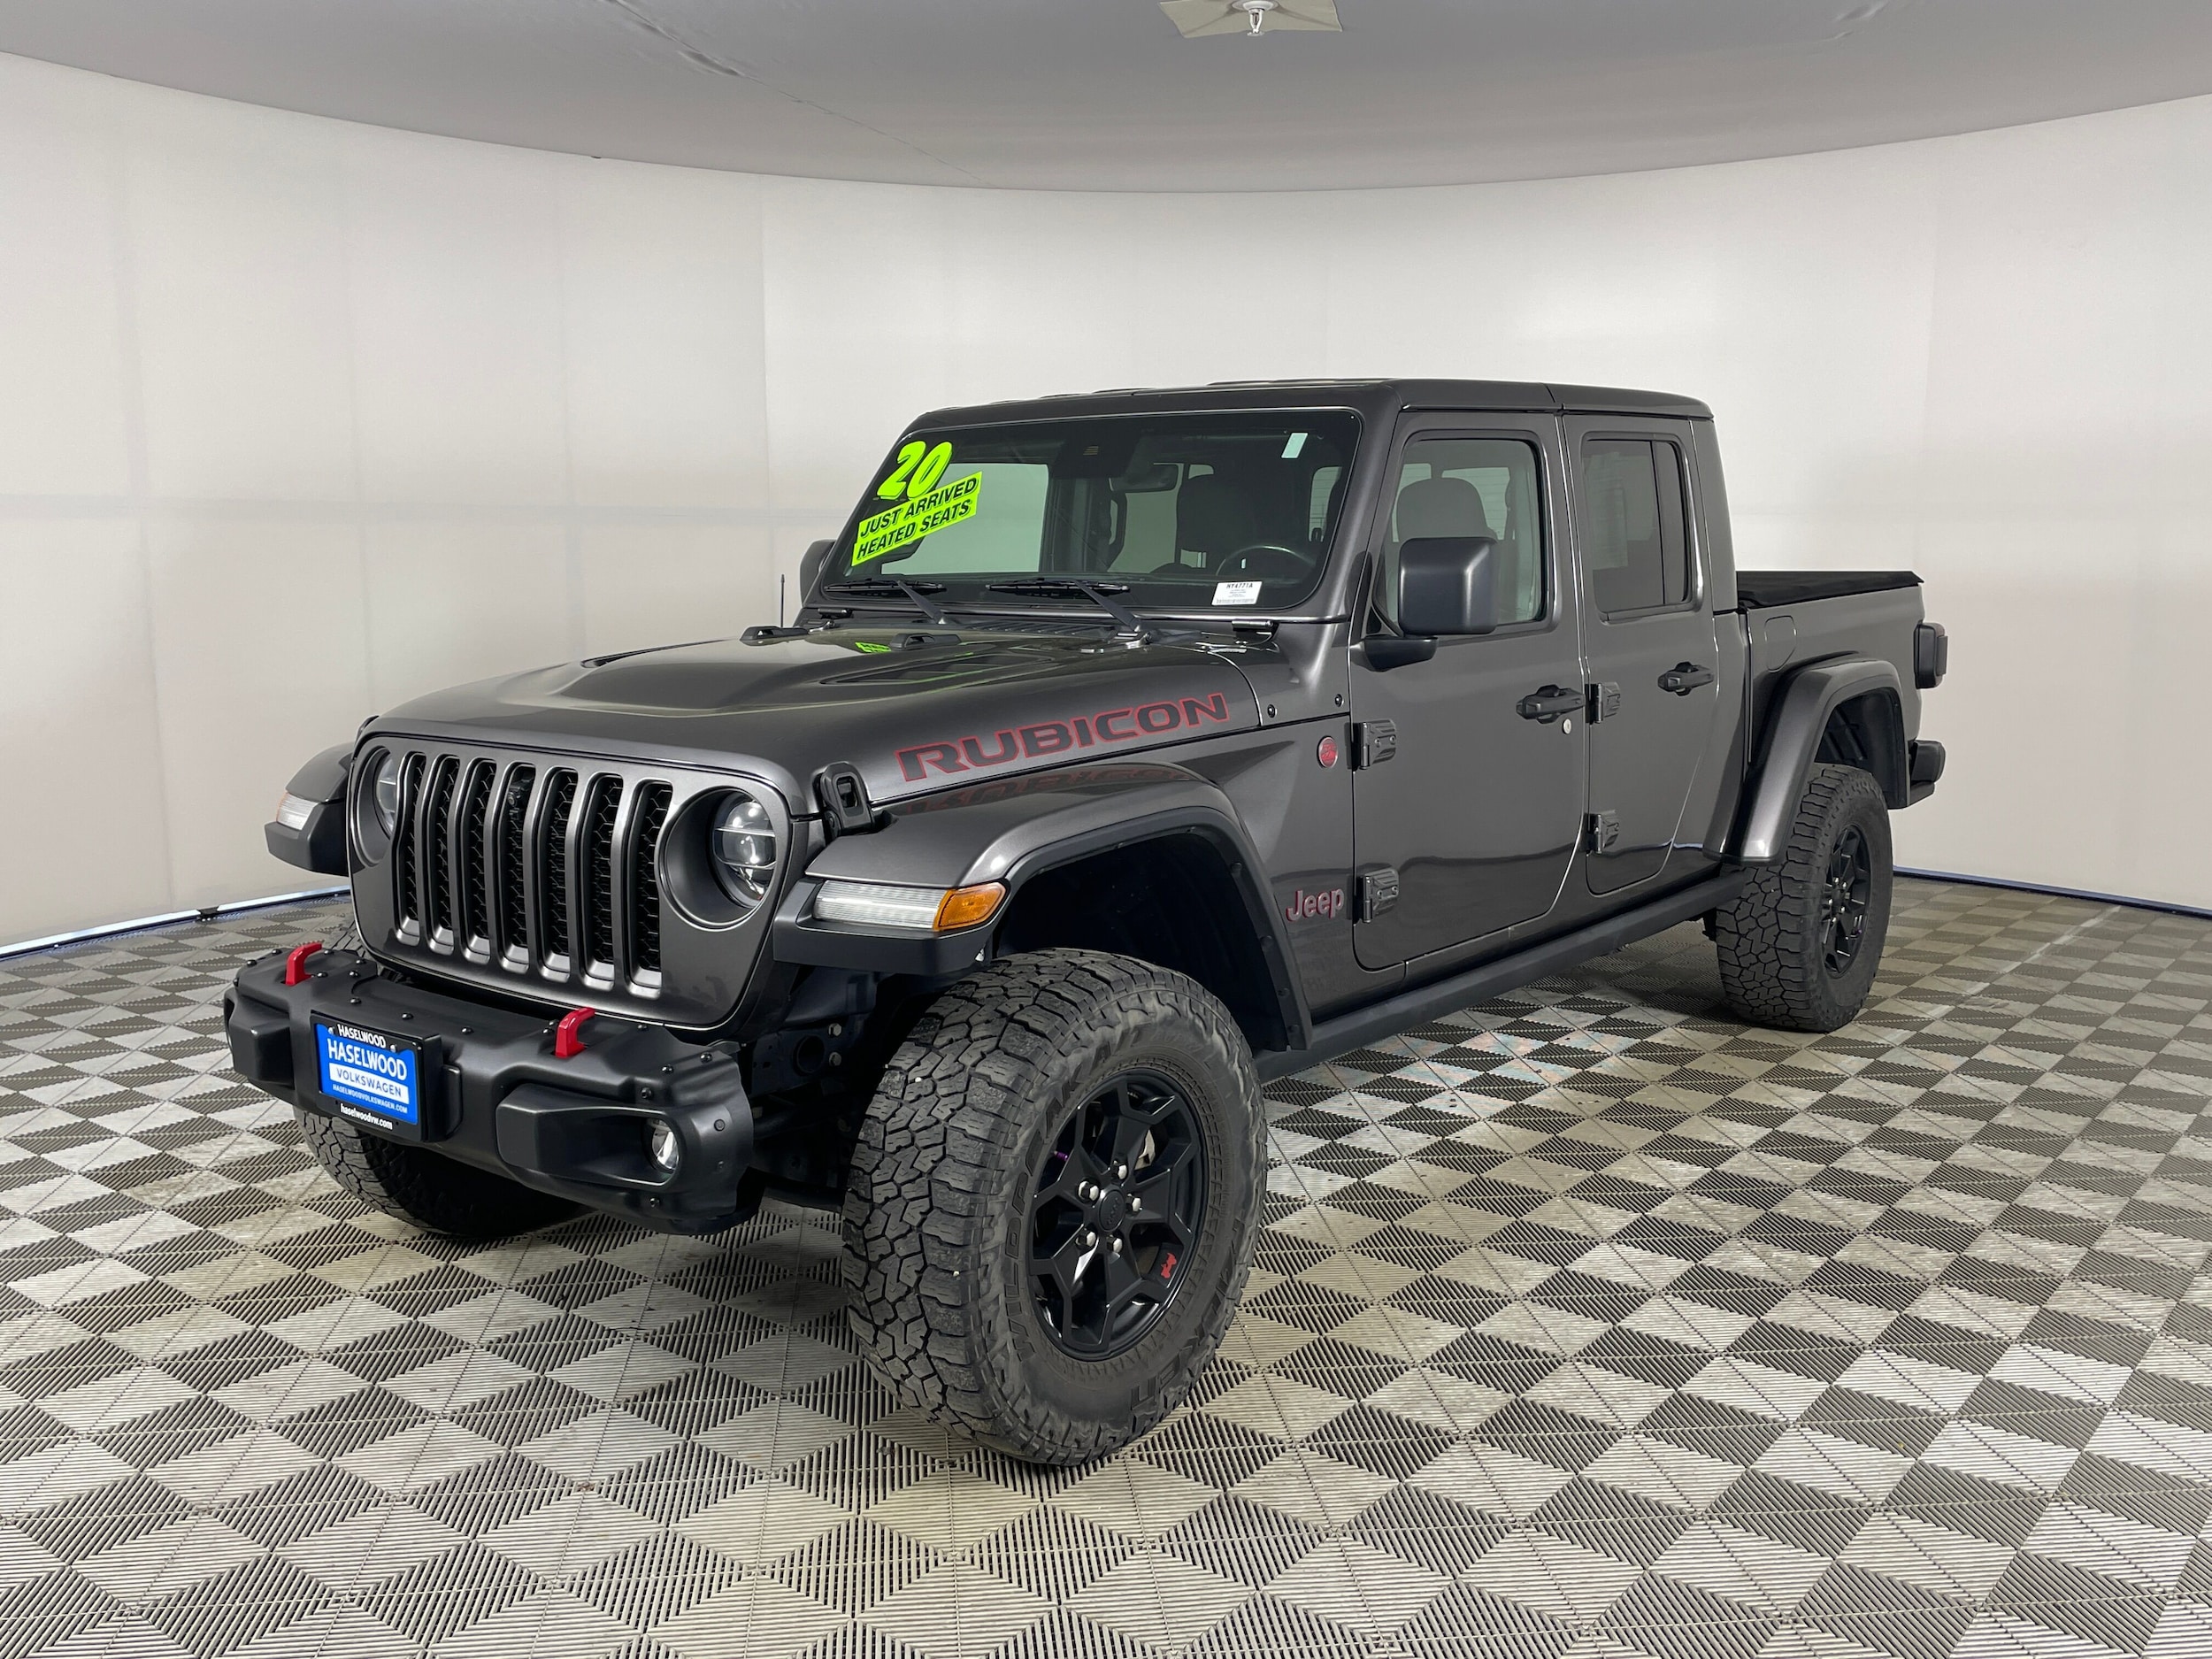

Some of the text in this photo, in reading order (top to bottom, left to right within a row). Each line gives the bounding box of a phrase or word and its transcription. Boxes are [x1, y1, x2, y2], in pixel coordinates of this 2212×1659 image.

[876, 441, 953, 501] 20
[860, 478, 979, 538] JUST ARRIVED
[856, 499, 972, 560] HEATED SEATS
[895, 692, 1230, 782] RUBICON
[1286, 888, 1345, 922] Jeep
[337, 1024, 387, 1048] HASELWOOD
[327, 1038, 408, 1081] HASELWOOD
[333, 1084, 408, 1114] HASELWOODVOLKSWAGEN.COM
[336, 1068, 402, 1097] VOLKSWAGEN
[340, 1103, 393, 1130] haselwoodvw.com
